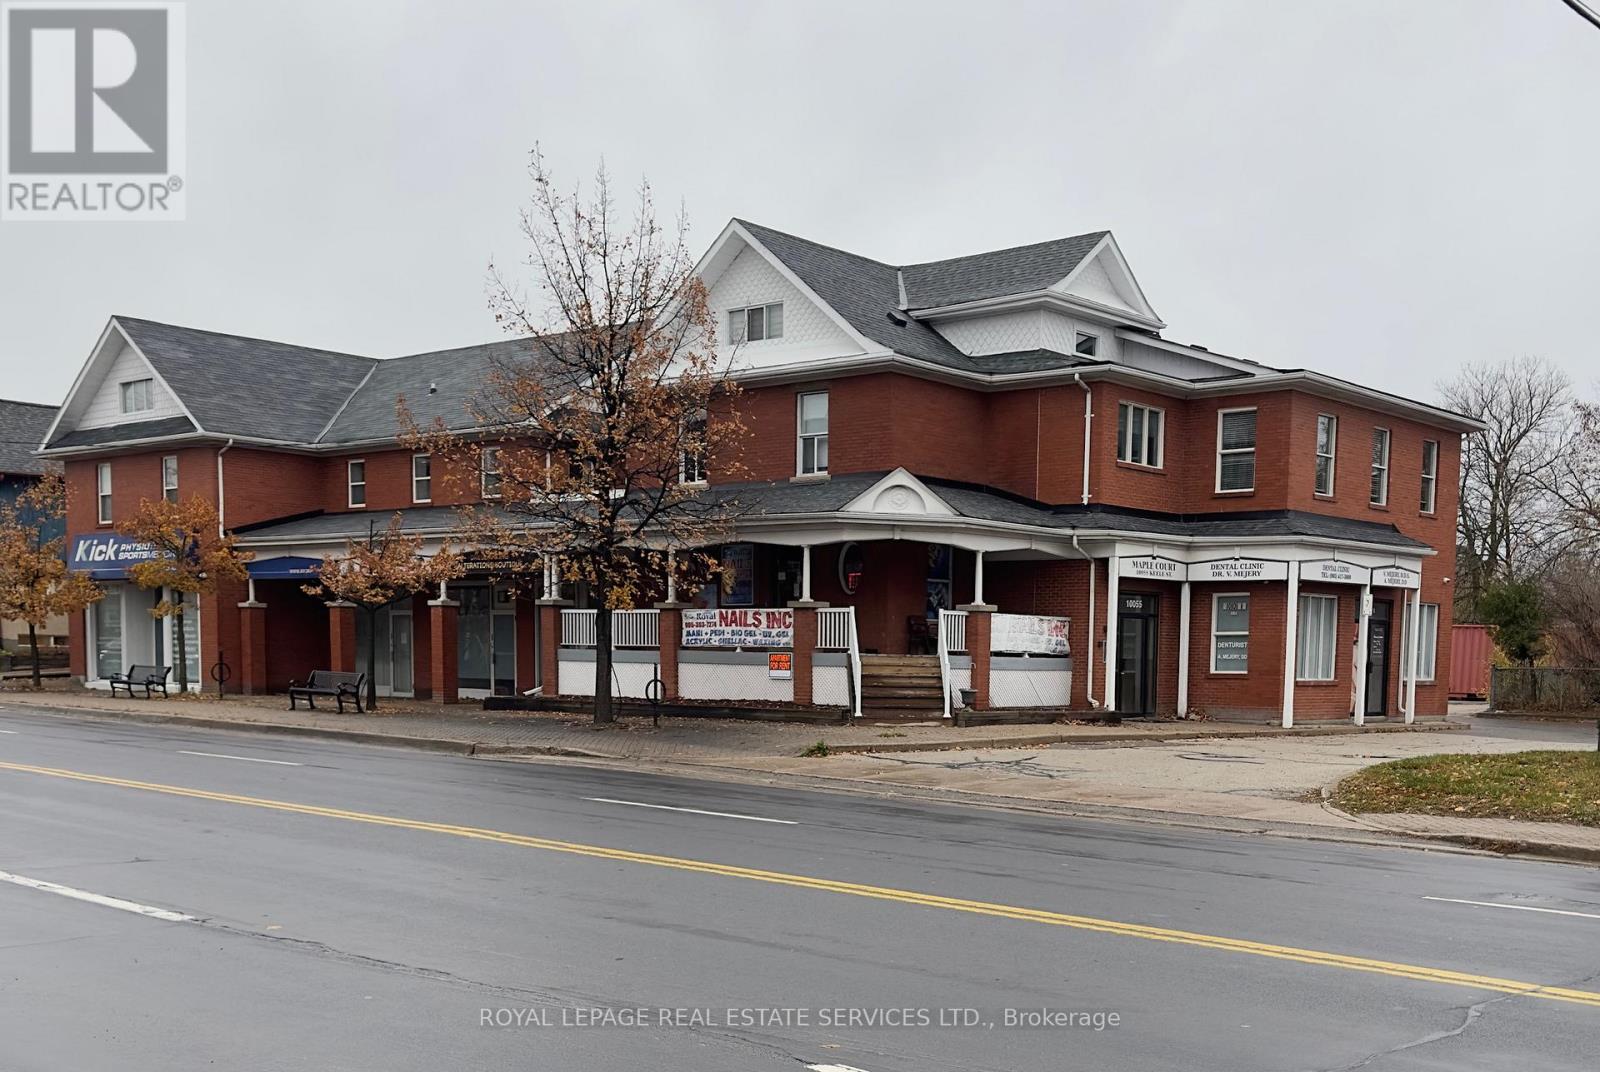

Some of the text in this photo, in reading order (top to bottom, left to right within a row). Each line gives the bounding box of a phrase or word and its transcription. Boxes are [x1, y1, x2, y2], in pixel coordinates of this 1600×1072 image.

[75, 538, 118, 561] Kick
[1132, 561, 1177, 571] MAPLE COURT
[1126, 600, 1143, 608] 10055
[719, 610, 762, 628] NAILS
[766, 611, 792, 629] INC
[779, 662, 790, 670] RENT
